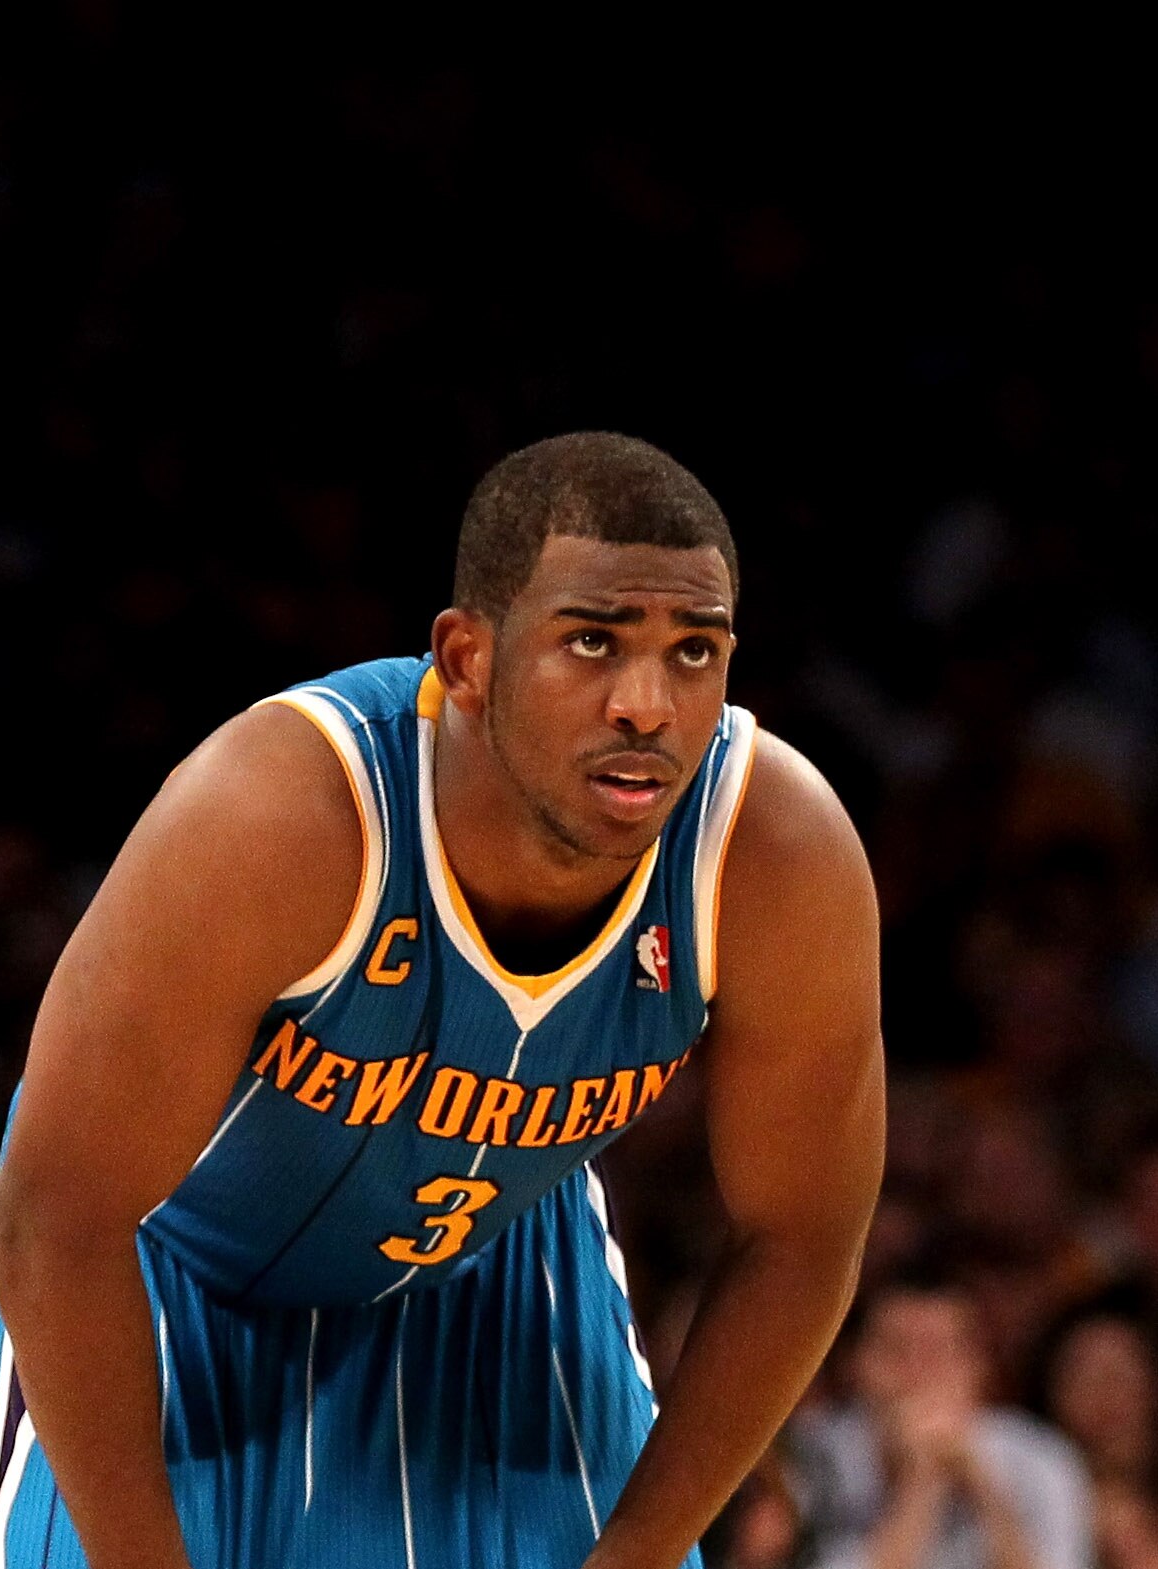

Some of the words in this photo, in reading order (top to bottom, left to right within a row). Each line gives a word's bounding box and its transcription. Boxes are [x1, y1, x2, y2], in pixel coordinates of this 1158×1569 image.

[364, 918, 418, 986] C
[252, 1018, 430, 1126] NEW
[418, 1047, 692, 1147] ORLEAN
[379, 1176, 499, 1265] 3
